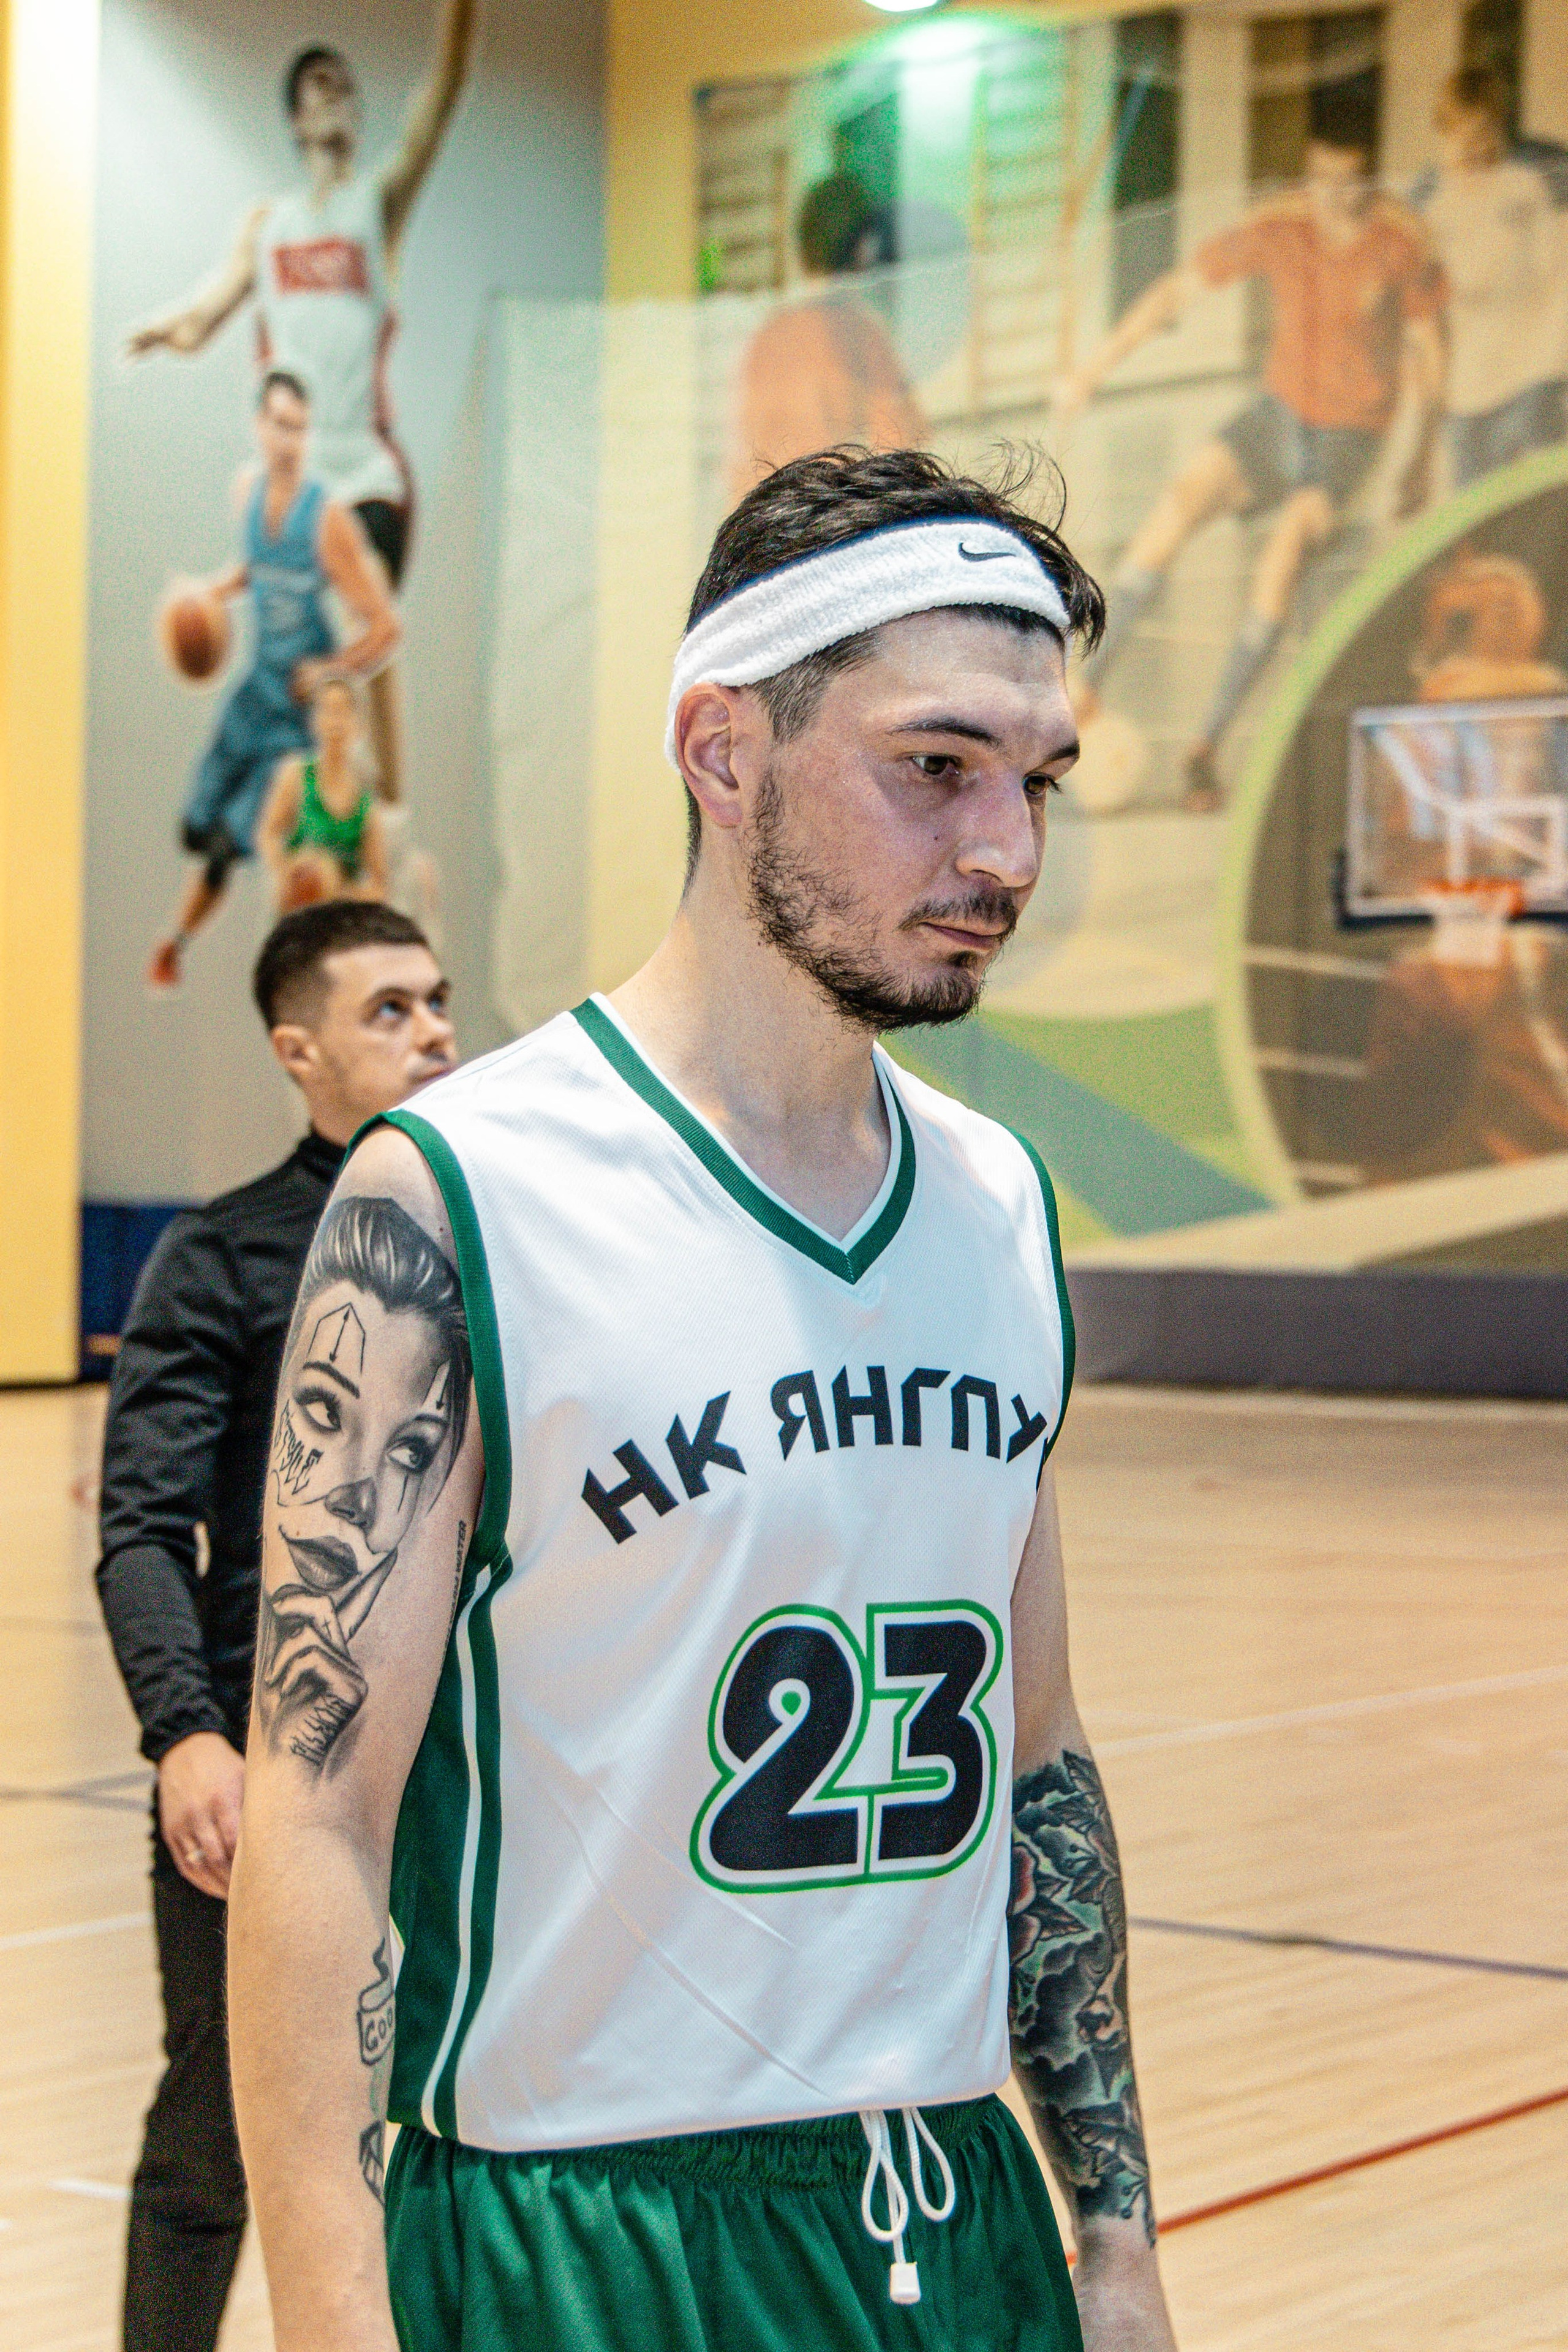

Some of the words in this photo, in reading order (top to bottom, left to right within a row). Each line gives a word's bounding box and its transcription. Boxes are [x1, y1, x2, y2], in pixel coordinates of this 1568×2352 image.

[581, 1390, 747, 1544] НК
[770, 1365, 1048, 1494] ЯНГПУ
[689, 1599, 1003, 1894] 23
